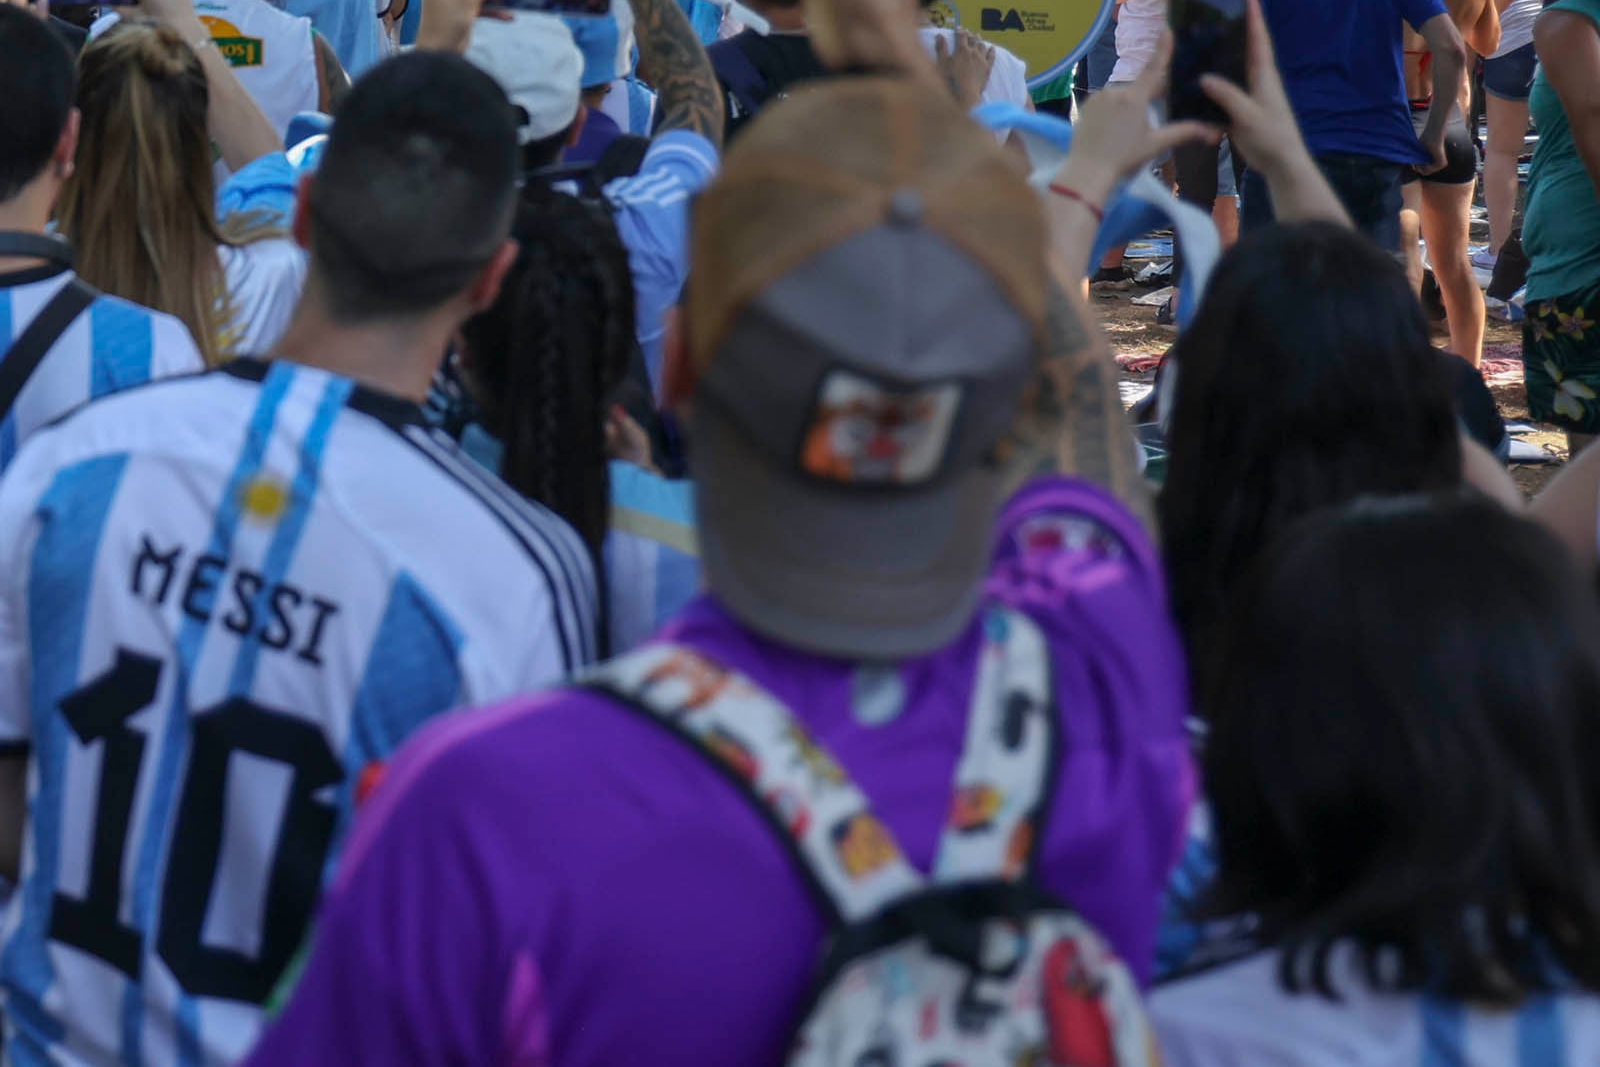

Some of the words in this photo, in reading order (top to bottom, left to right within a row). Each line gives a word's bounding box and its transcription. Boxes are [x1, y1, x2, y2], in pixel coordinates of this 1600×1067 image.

[981, 8, 1024, 32] BA
[130, 534, 339, 666] MESSI
[48, 643, 346, 1007] 10
